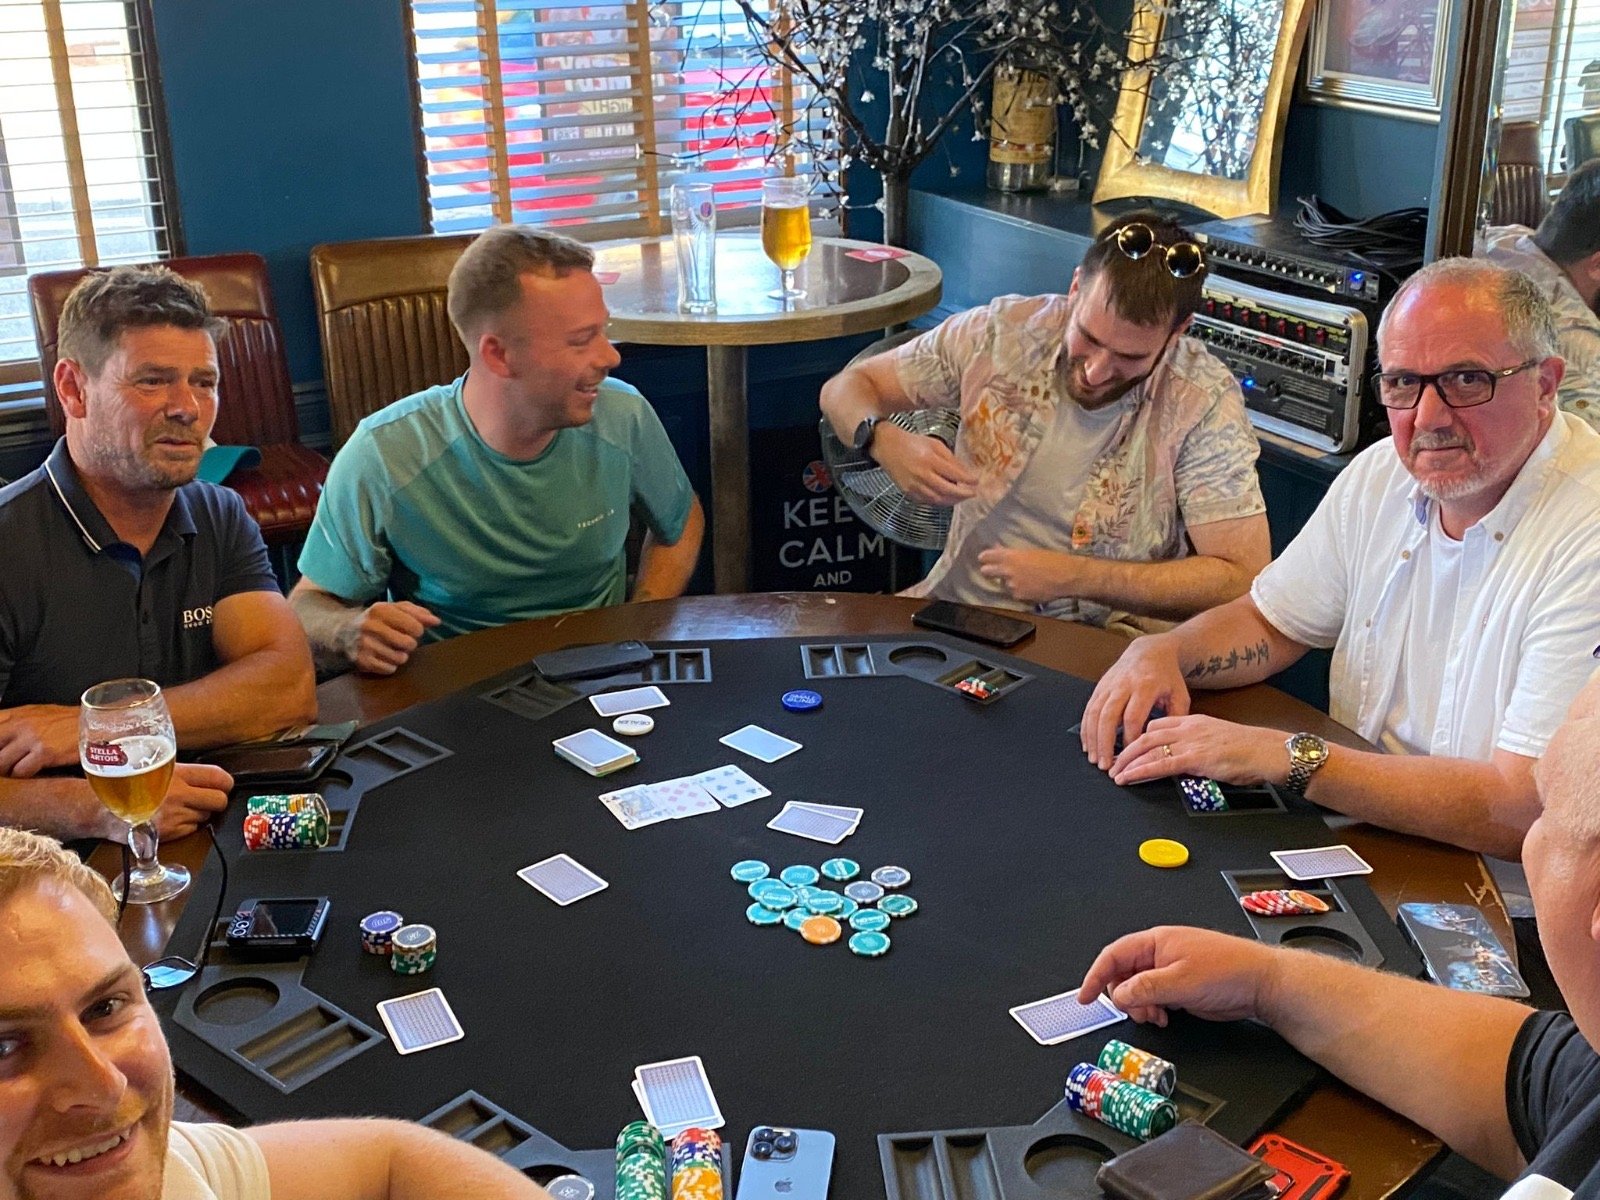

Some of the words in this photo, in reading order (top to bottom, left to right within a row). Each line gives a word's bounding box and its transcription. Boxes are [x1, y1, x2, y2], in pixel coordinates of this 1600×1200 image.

[783, 495, 853, 529] KEE
[779, 532, 884, 568] CALM
[813, 570, 852, 587] AND
[183, 606, 213, 623] BOS
[90, 746, 118, 755] STELLA
[90, 754, 119, 762] ARTOIS
